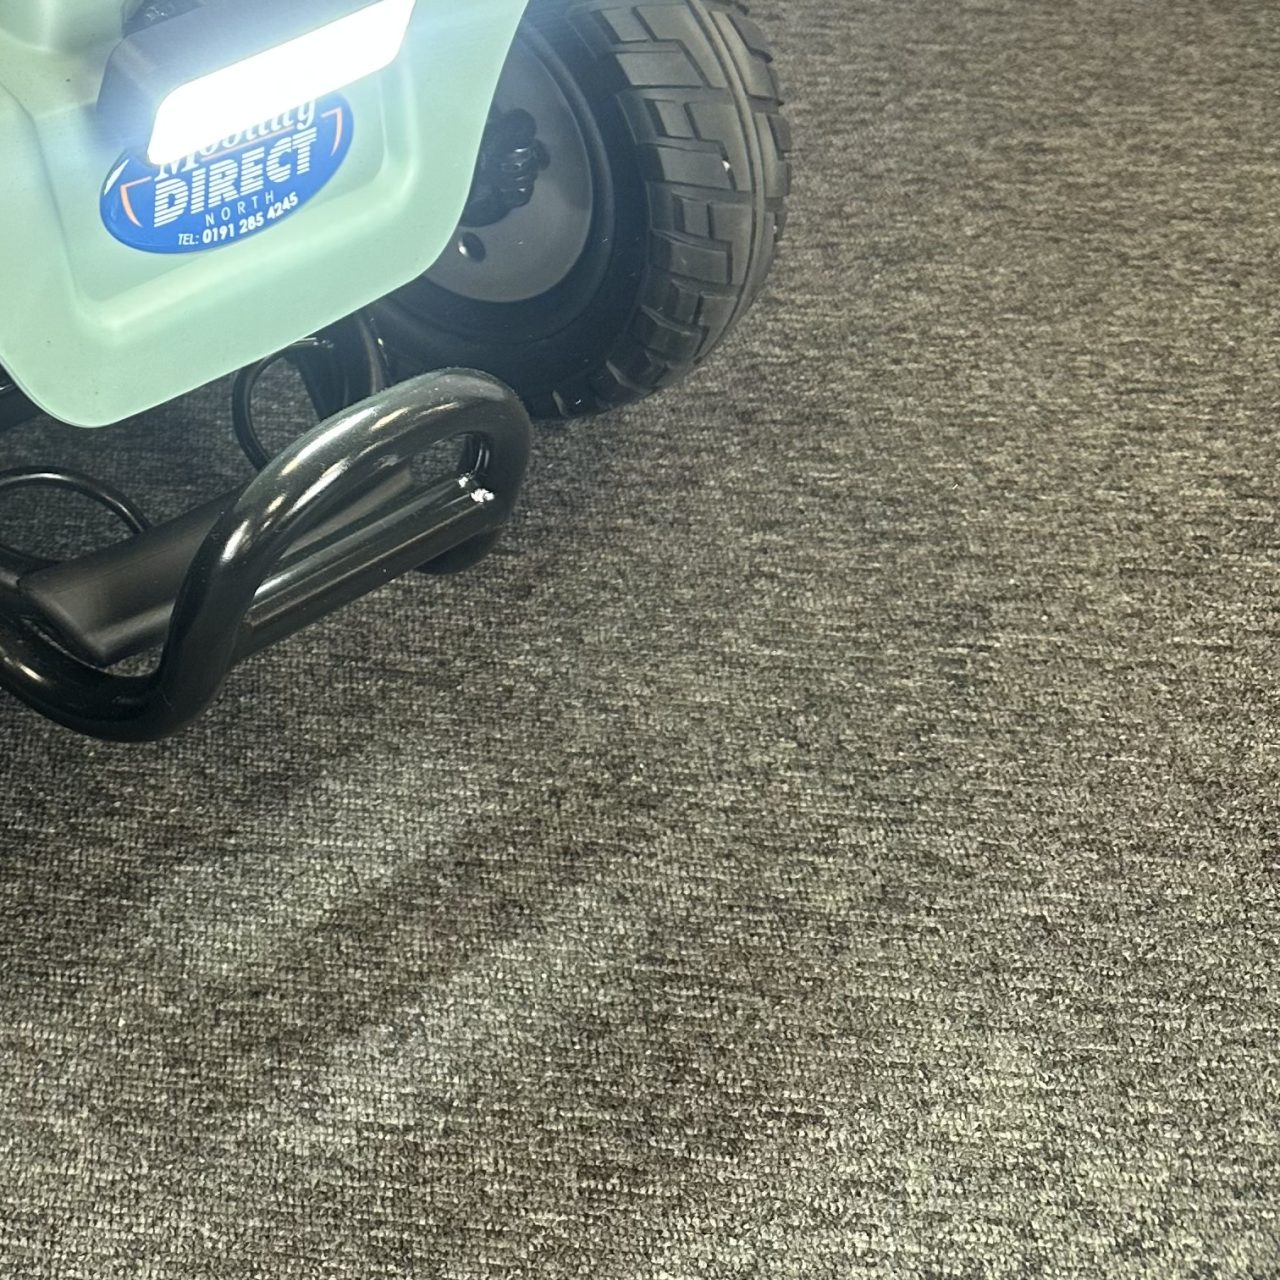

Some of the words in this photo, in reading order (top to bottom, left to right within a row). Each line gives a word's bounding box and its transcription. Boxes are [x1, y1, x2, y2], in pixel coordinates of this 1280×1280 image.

[153, 126, 317, 228] DIRECT
[177, 232, 200, 246] TEL:
[202, 223, 235, 244] 0191
[239, 211, 265, 234] 285
[266, 191, 299, 220] 4245
[204, 189, 275, 227] NORTH
